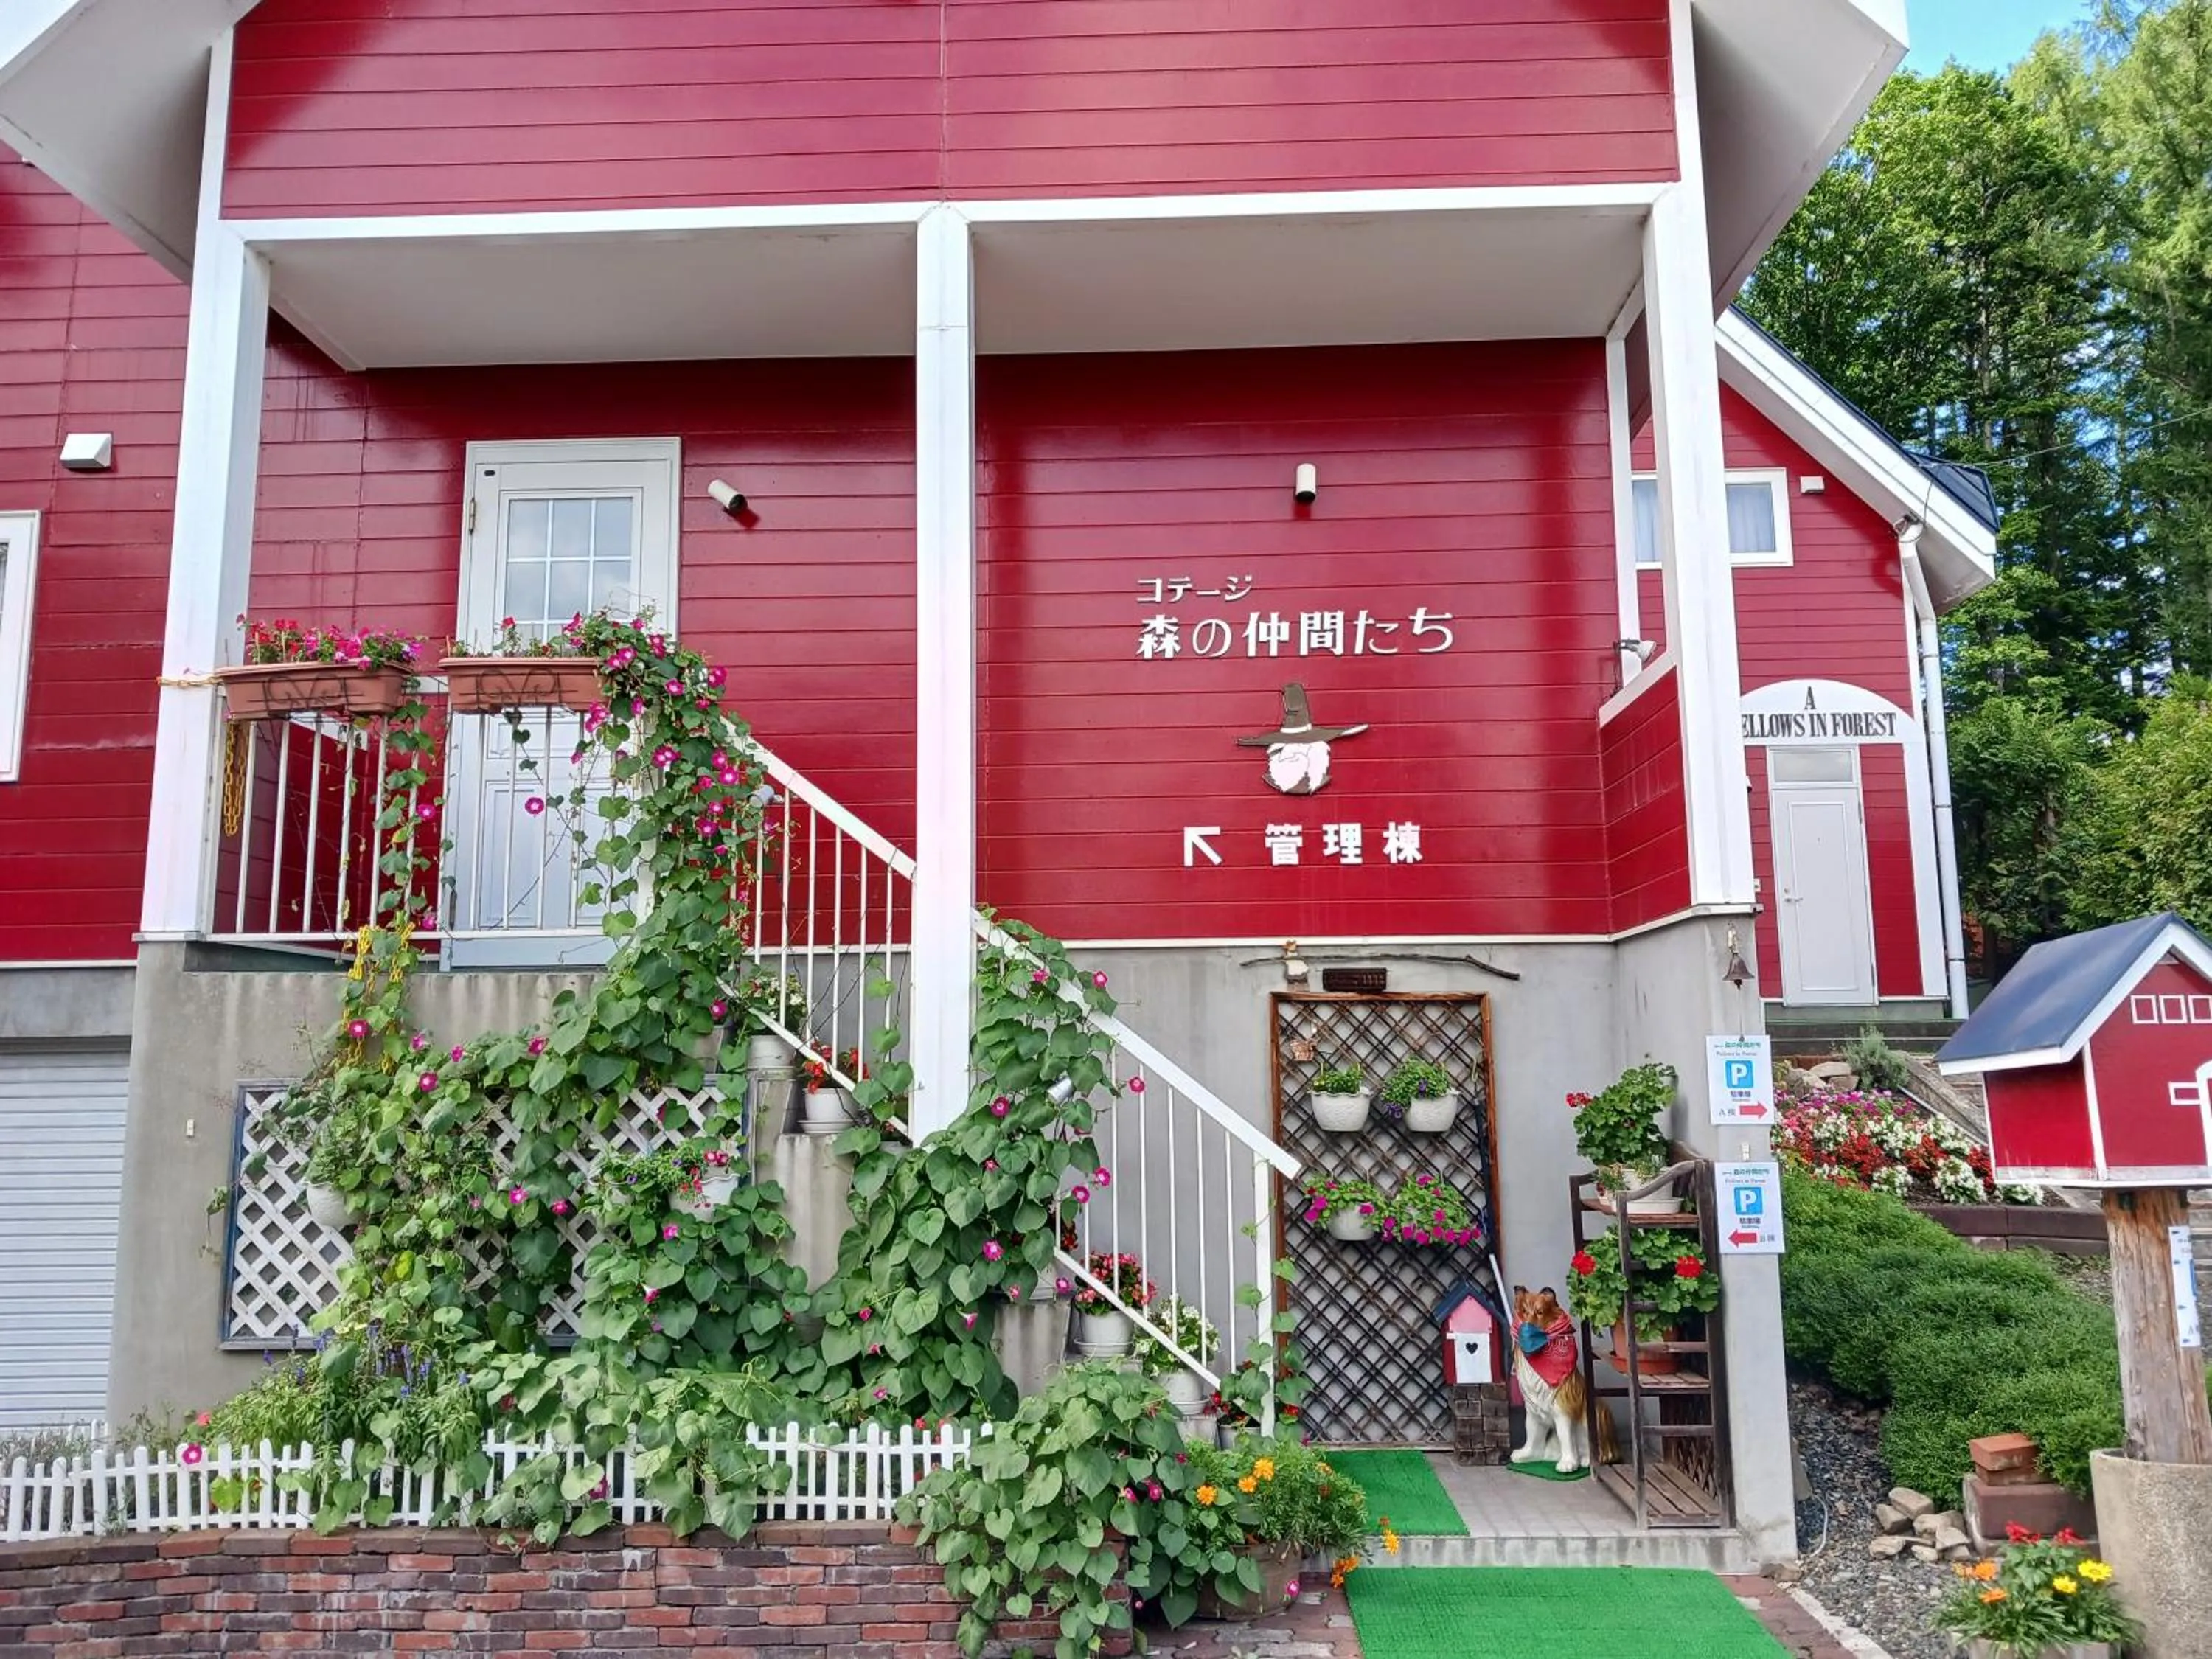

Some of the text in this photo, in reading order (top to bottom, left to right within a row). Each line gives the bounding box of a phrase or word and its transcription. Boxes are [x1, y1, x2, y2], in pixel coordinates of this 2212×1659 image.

[1136, 574, 1253, 603] コテージ
[1135, 607, 1454, 660] 森の仲間たち
[1804, 686, 1816, 709] A
[1809, 713, 1828, 737] IN
[1830, 712, 1896, 737] FOREST
[1265, 821, 1423, 866] 管理棟
[1731, 1063, 1747, 1086] P
[1740, 1190, 1757, 1213] P
